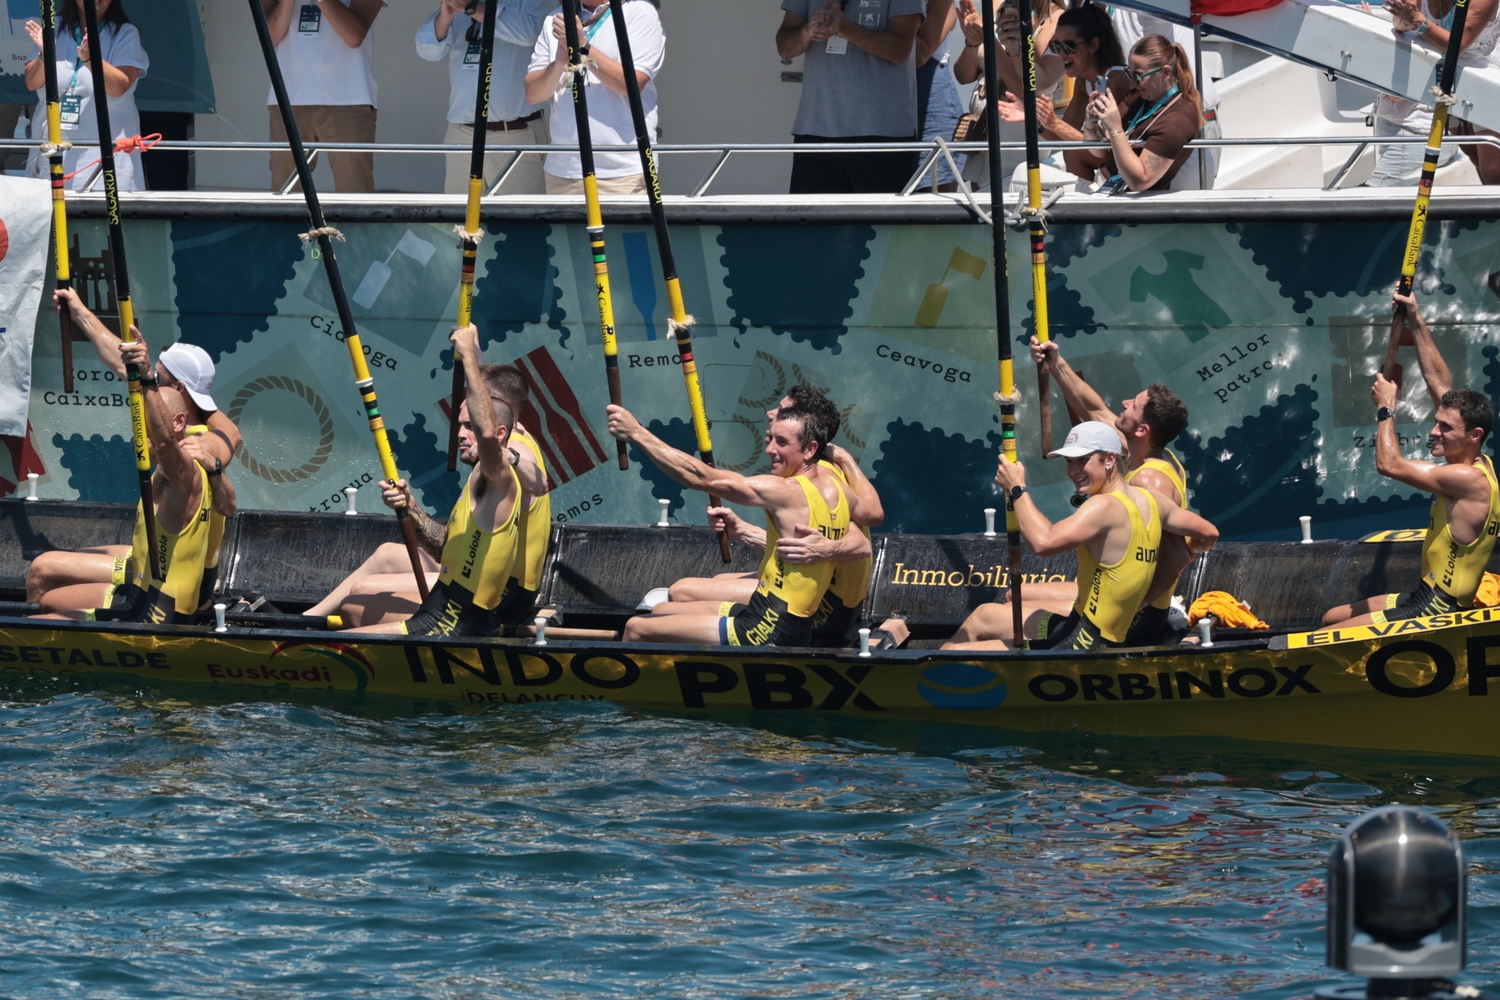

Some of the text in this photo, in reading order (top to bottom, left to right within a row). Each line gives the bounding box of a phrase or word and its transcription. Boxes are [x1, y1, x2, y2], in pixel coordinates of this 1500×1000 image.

[1026, 34, 1037, 91] SAGARDI
[103, 169, 121, 226] SAGARDI
[645, 147, 663, 203] SAGARDI
[1406, 218, 1425, 267] CaixaBank
[309, 314, 398, 372] Ciaoga
[876, 343, 972, 384] Ceavoga
[1196, 332, 1270, 383] Mellor
[133, 399, 145, 448] CaixaBank
[551, 489, 604, 522] emos
[467, 530, 482, 567] Loiola
[1448, 542, 1459, 577] Loiola
[1091, 567, 1103, 603] Loiola
[1306, 630, 1355, 649] EL
[207, 662, 333, 684] Euskadi
[404, 645, 641, 690] INDO
[675, 661, 887, 711] PBX
[1027, 664, 1323, 702] ORBINOX
